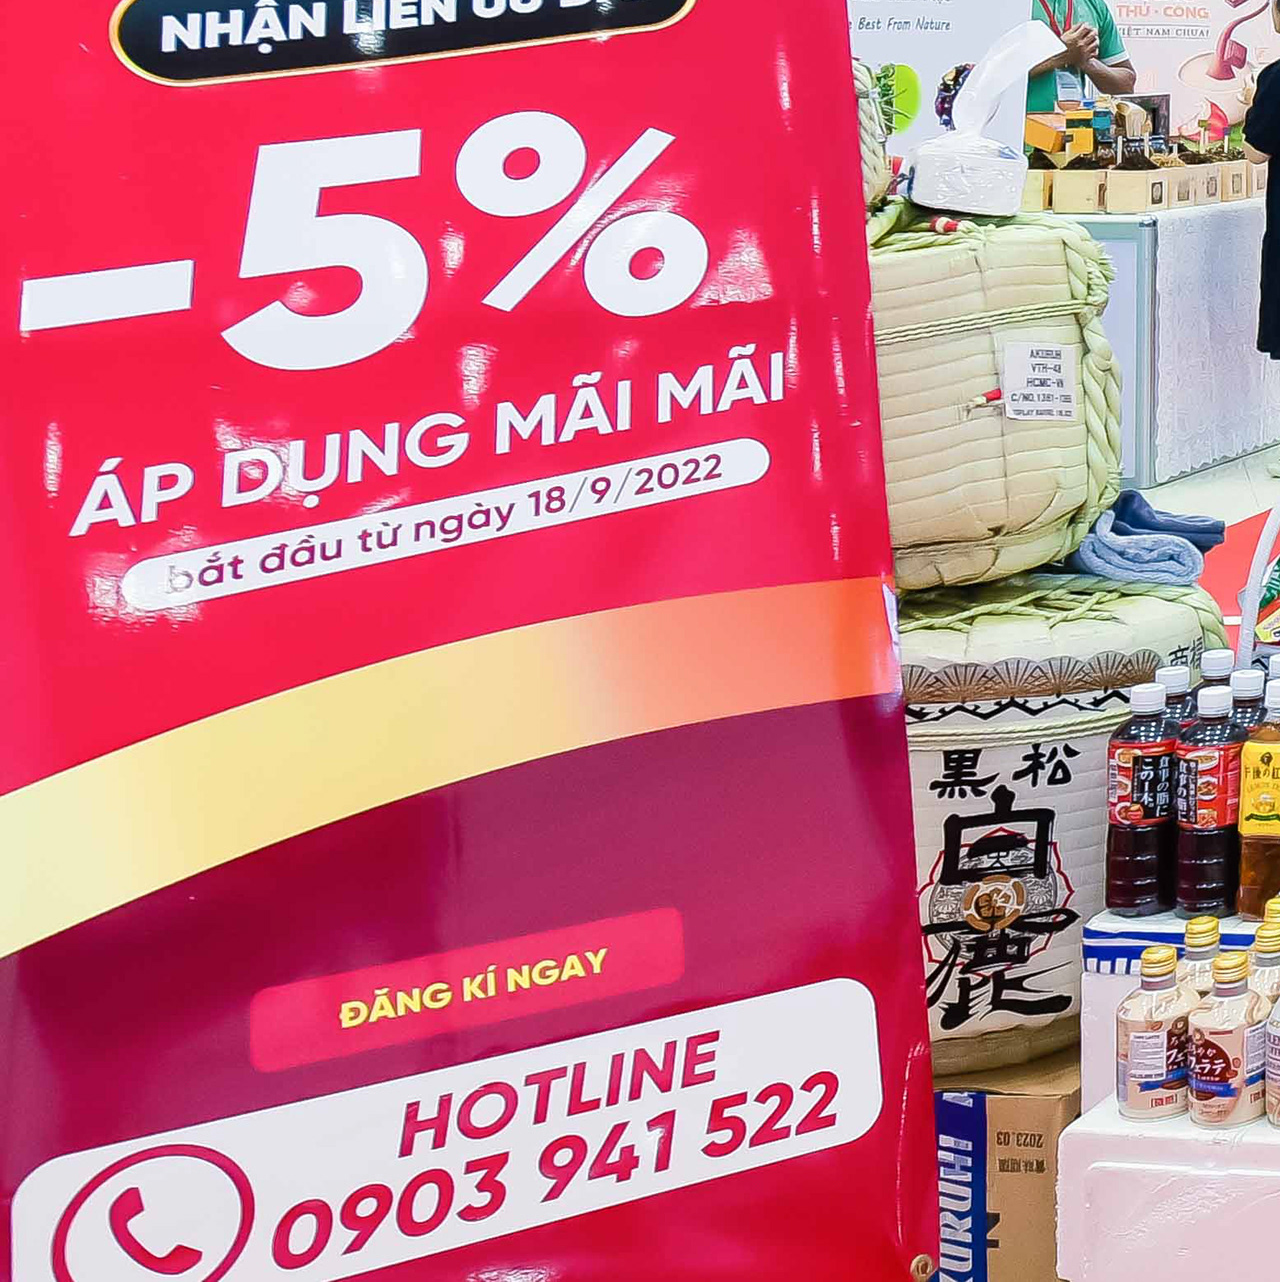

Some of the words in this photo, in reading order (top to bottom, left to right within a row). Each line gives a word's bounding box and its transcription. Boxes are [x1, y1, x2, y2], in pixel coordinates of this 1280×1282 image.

[858, 16, 881, 30] Best
[887, 17, 911, 31] From
[915, 17, 951, 31] Nature
[69, 462, 194, 537] ÁP
[221, 409, 471, 511] DỤNG
[493, 370, 631, 454] MÃI
[657, 342, 786, 423] MÃI
[165, 543, 246, 596] bắt
[258, 528, 344, 574] đầu
[358, 521, 406, 553] từ
[412, 498, 514, 547] ngày
[526, 452, 724, 519] 18/9/2022
[922, 785, 1081, 1032] 白鹿
[339, 982, 452, 1030] ĐĂNG
[462, 964, 499, 1004] KÍ
[507, 948, 609, 990] NGAY
[397, 1029, 722, 1158] HOTLINE
[270, 1157, 508, 1272] 0903
[538, 1119, 675, 1203] 941
[702, 1070, 839, 1158] 522
